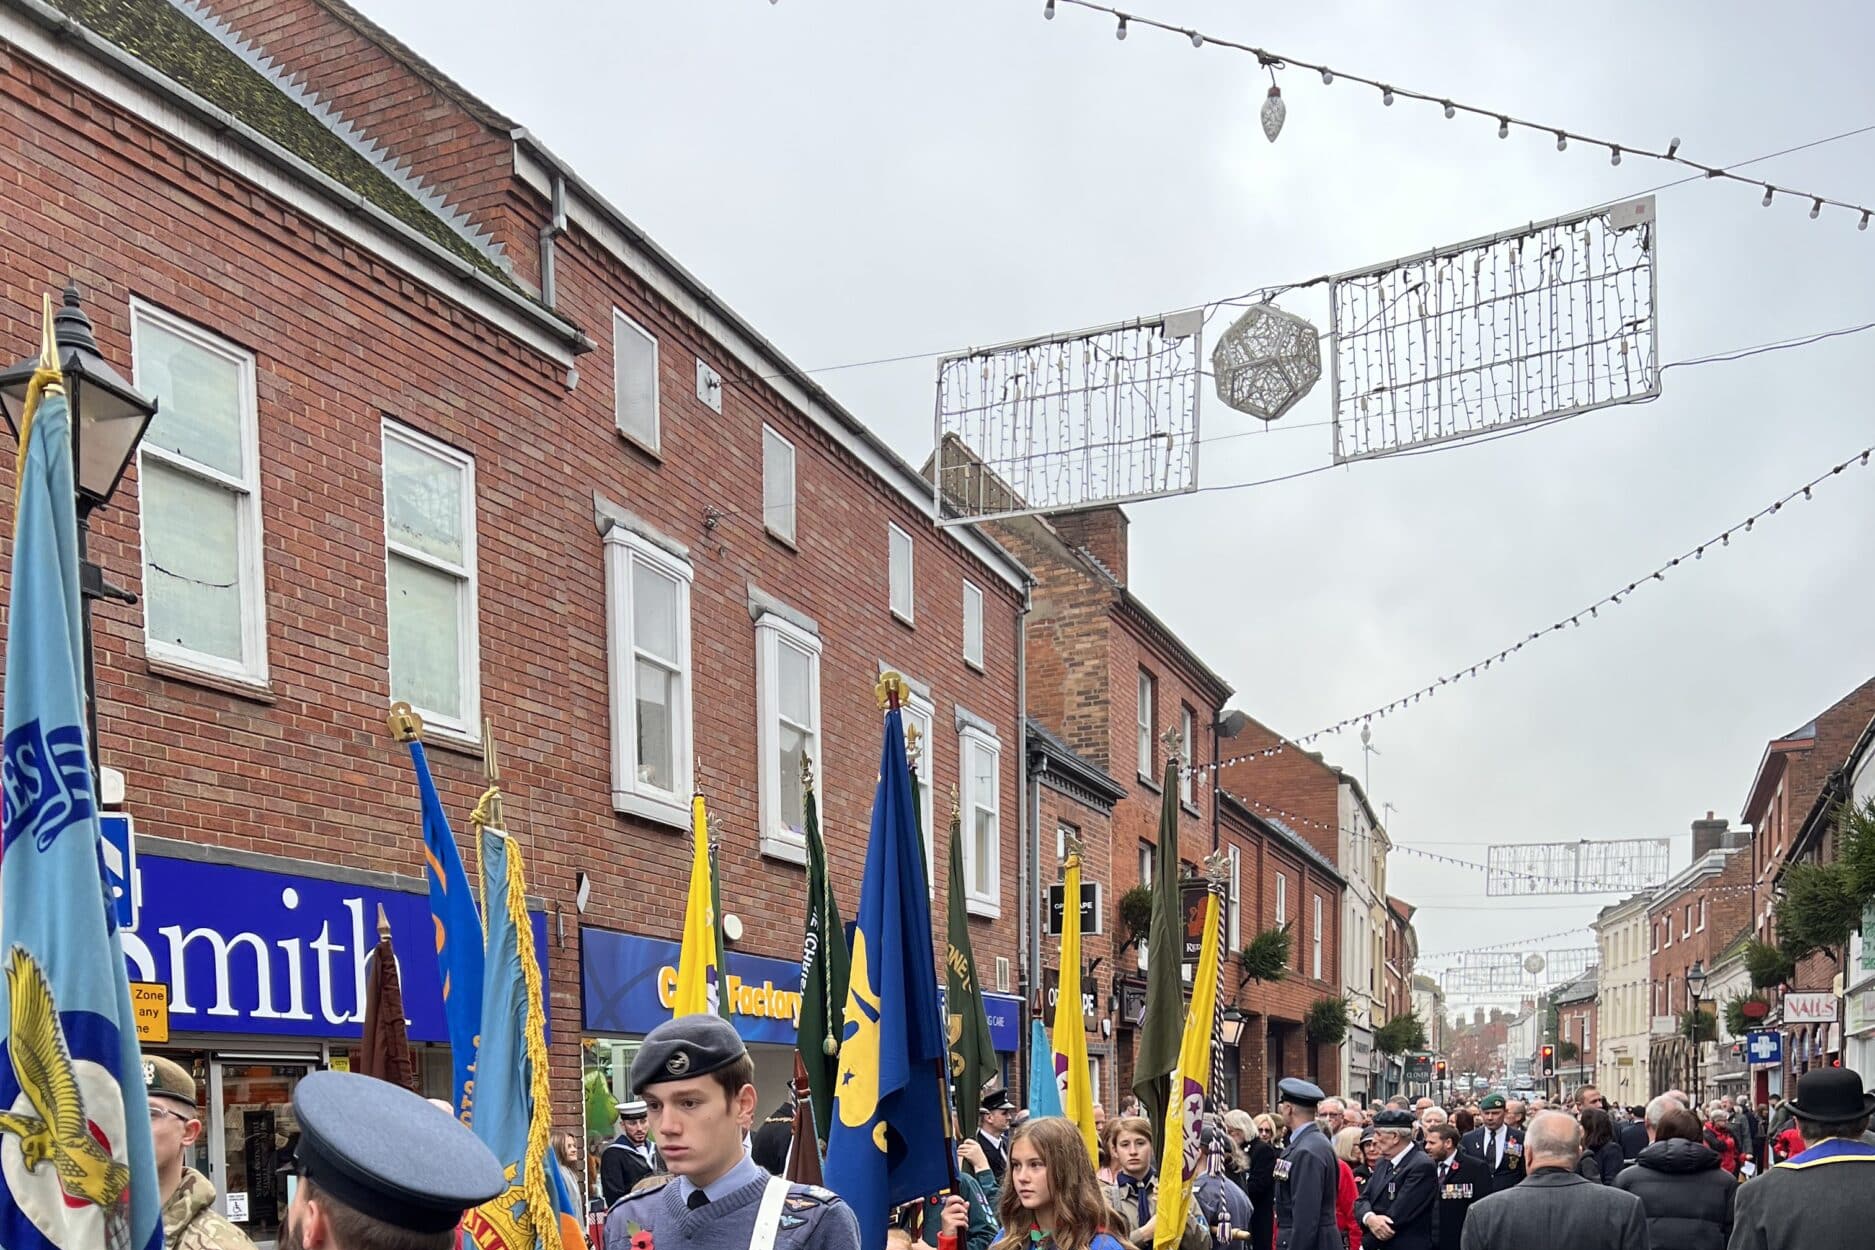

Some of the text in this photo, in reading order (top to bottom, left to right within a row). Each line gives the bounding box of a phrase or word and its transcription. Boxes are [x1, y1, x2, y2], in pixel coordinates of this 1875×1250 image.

[135, 989, 164, 1001] Zone
[725, 973, 803, 1030] Factory
[138, 1008, 159, 1019] any
[1788, 997, 1835, 1018] NAILS
